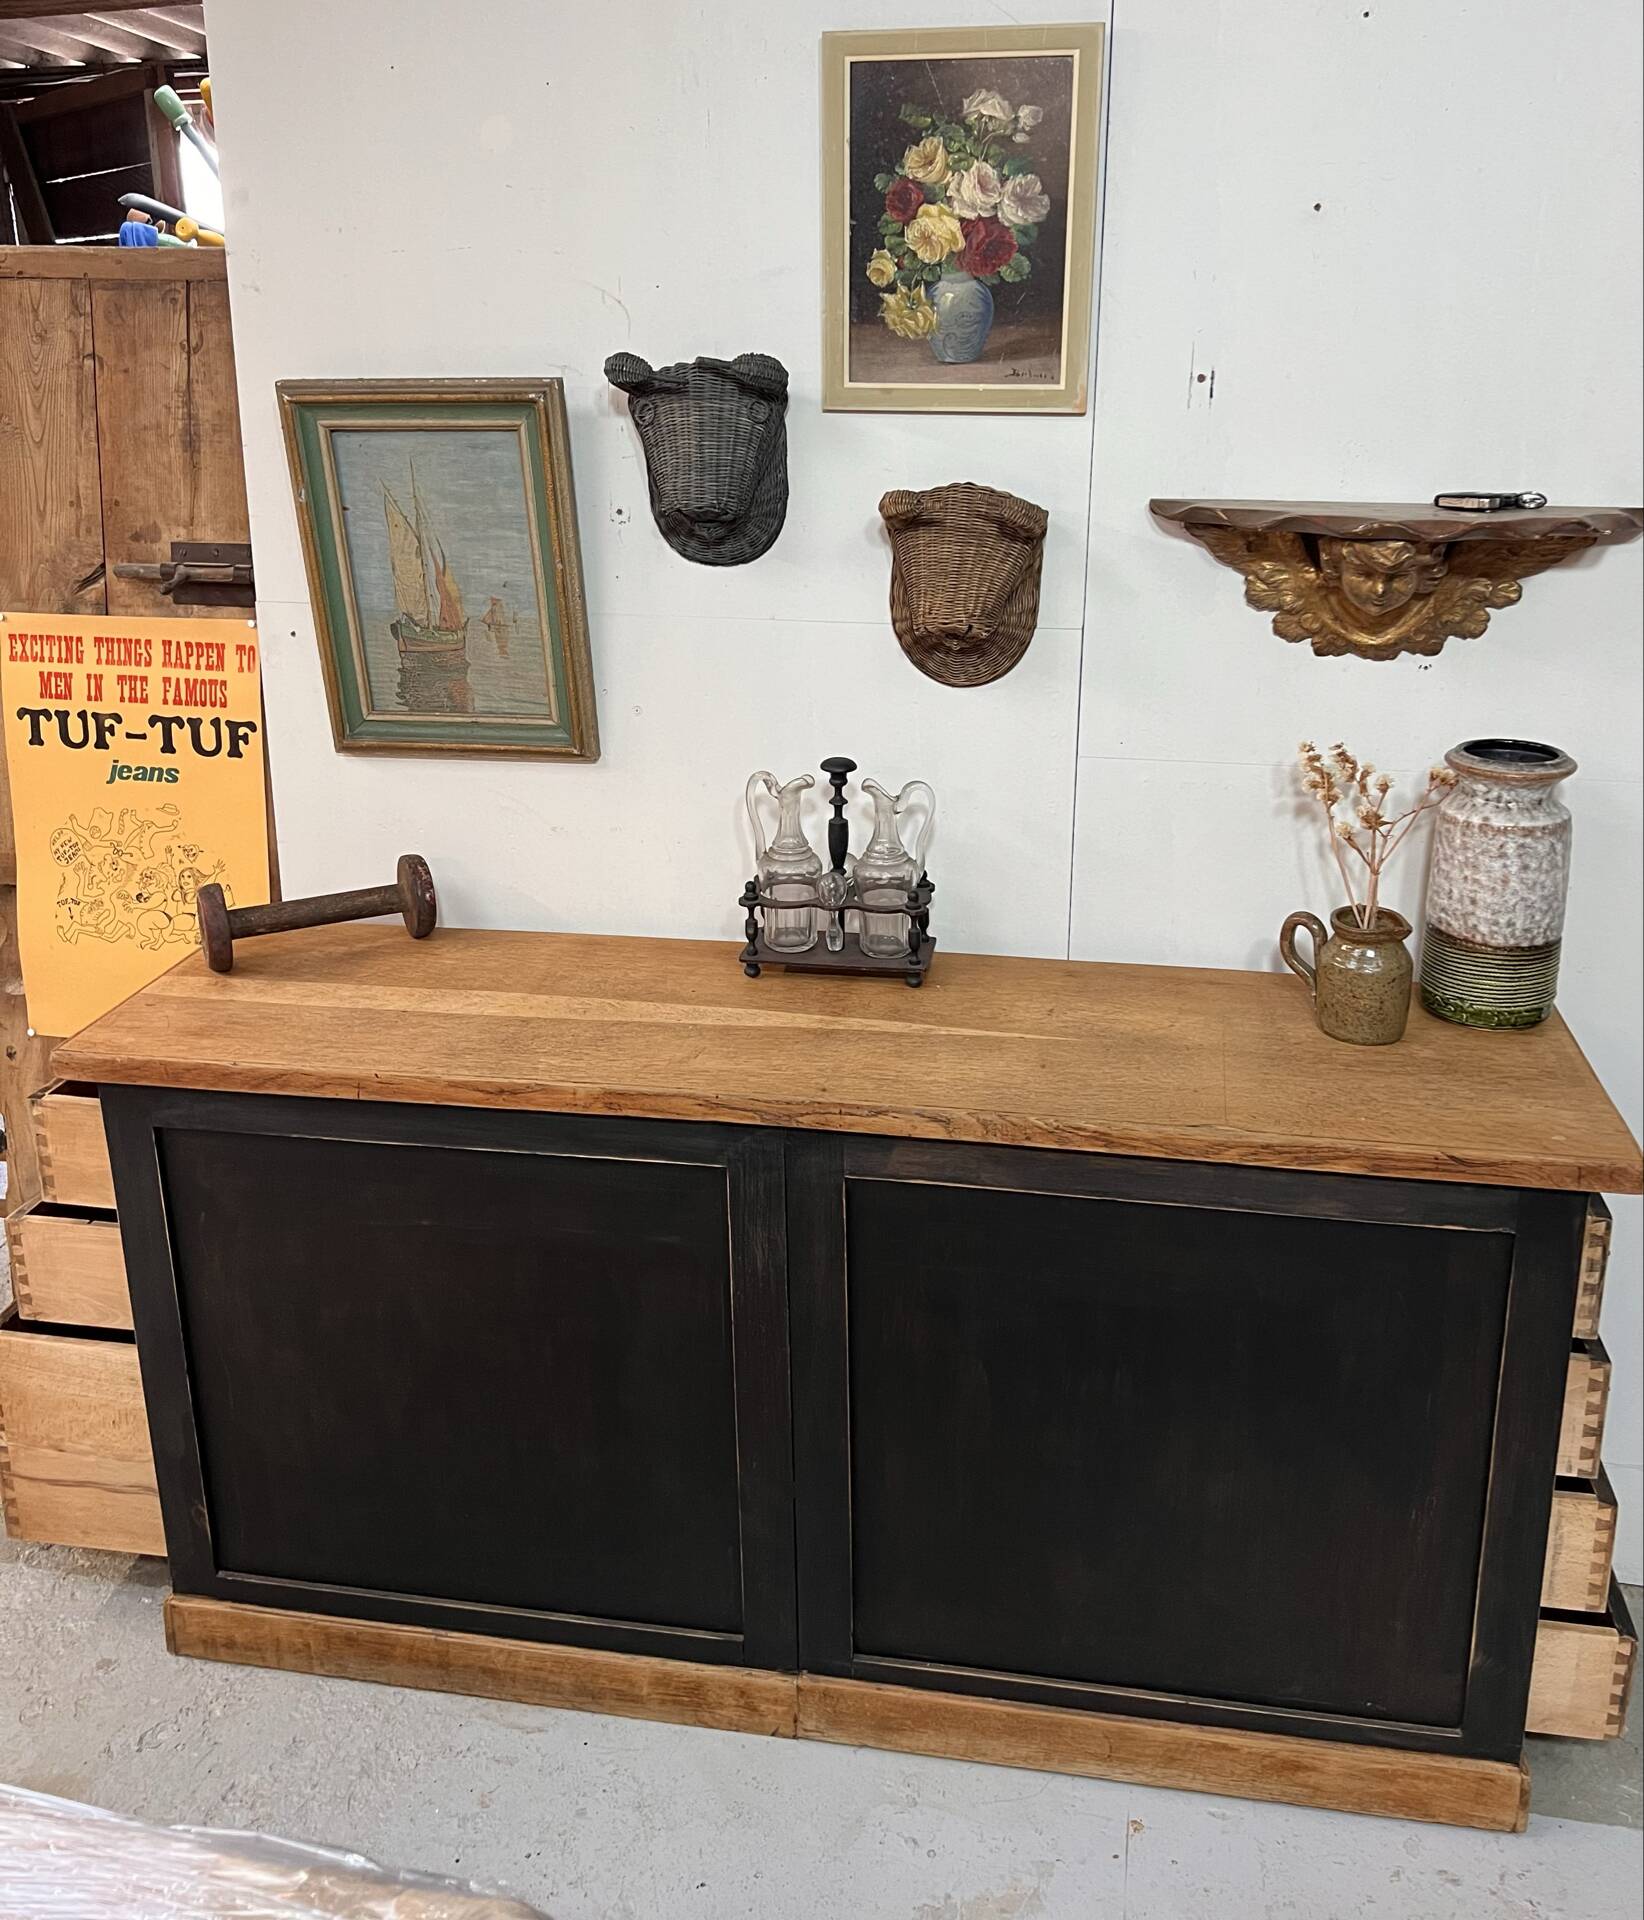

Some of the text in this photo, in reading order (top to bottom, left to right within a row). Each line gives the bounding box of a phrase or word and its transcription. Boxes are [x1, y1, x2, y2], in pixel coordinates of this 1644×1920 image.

[8, 634, 256, 673] EXCITING THINGS HAPPEN TO
[39, 671, 228, 708] MEN IN THE FAMOUS
[17, 707, 257, 758] TUF-TUF
[106, 760, 180, 784] jeans
